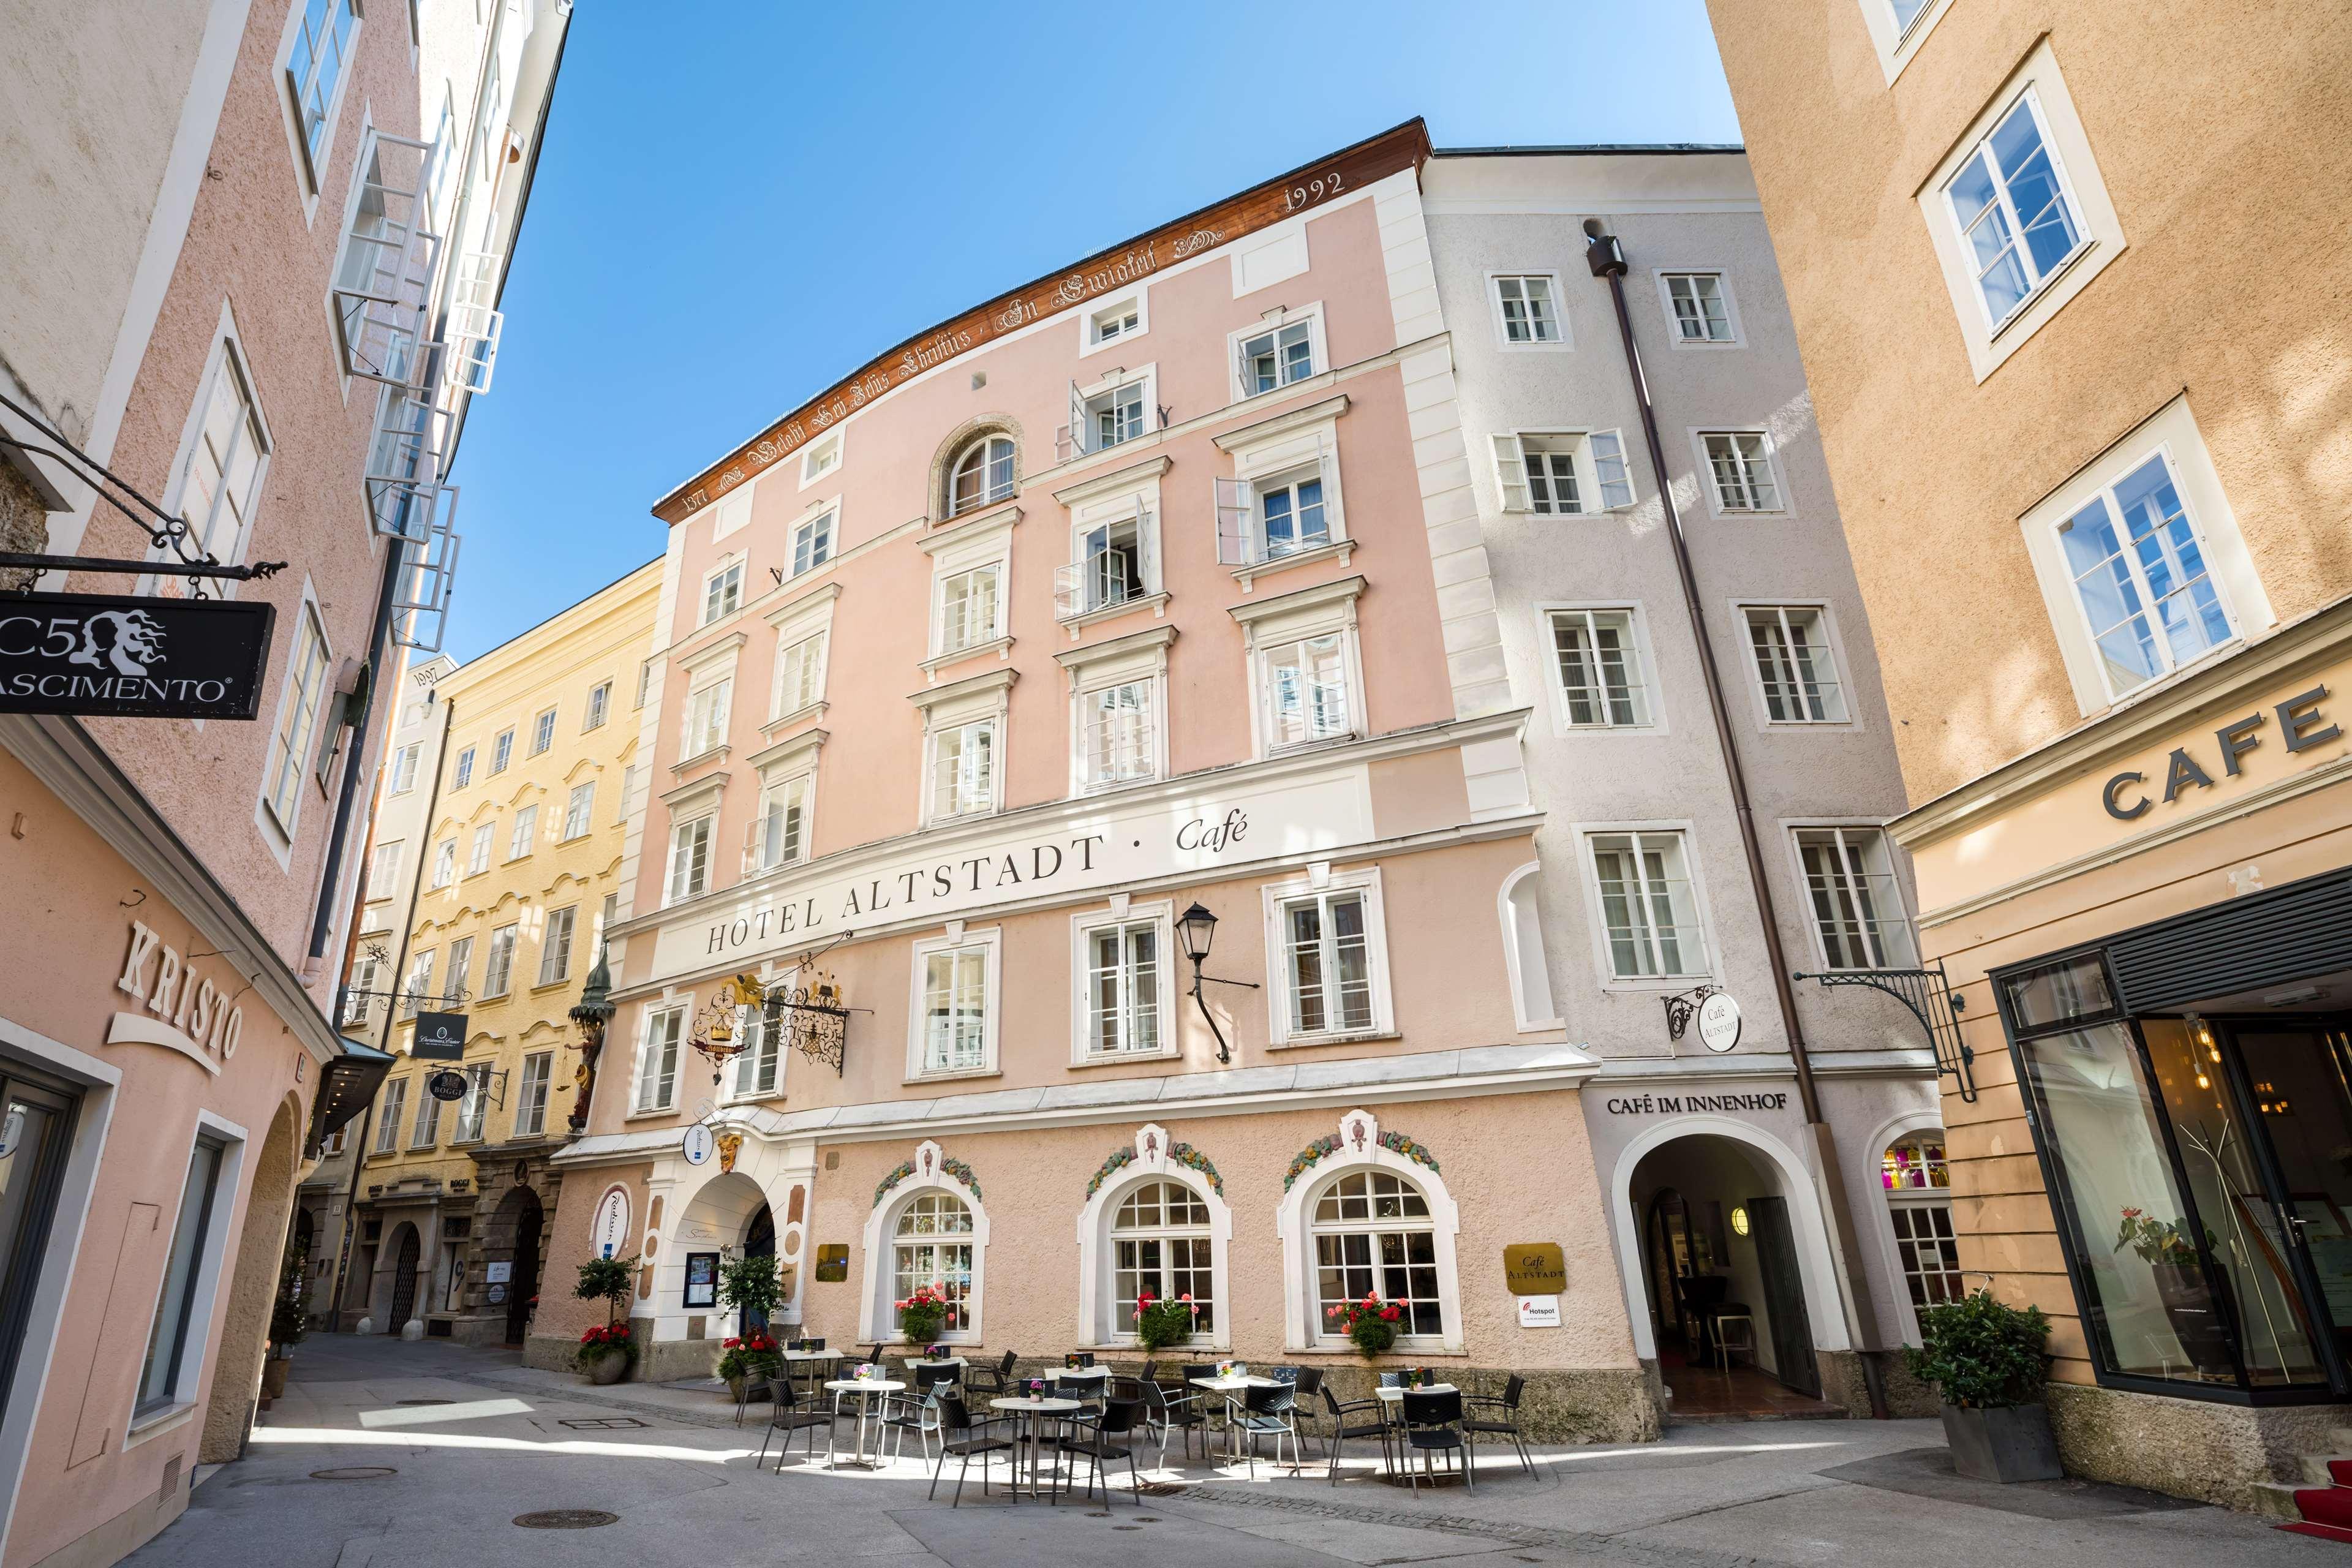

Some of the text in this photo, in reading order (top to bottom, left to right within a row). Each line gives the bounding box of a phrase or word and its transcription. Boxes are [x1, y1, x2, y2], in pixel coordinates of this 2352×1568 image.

[682, 489, 707, 513] 1377
[1284, 172, 1346, 213] 1992
[0, 617, 78, 657] C5
[2102, 683, 2341, 820] CAFE
[706, 808, 1248, 954] HOTEL ALTSTADT Café
[118, 919, 243, 1060] KRISTO
[1708, 1005, 1725, 1020] Café
[1705, 1021, 1736, 1038] ALTSTADT
[434, 1087, 462, 1096] BOGGI
[1607, 1093, 1787, 1114] CAFÉ IM INNENHOF
[608, 1195, 620, 1240] Radisson
[1507, 1270, 1564, 1280] ALTSTADT
[1523, 1255, 1544, 1270] Café
